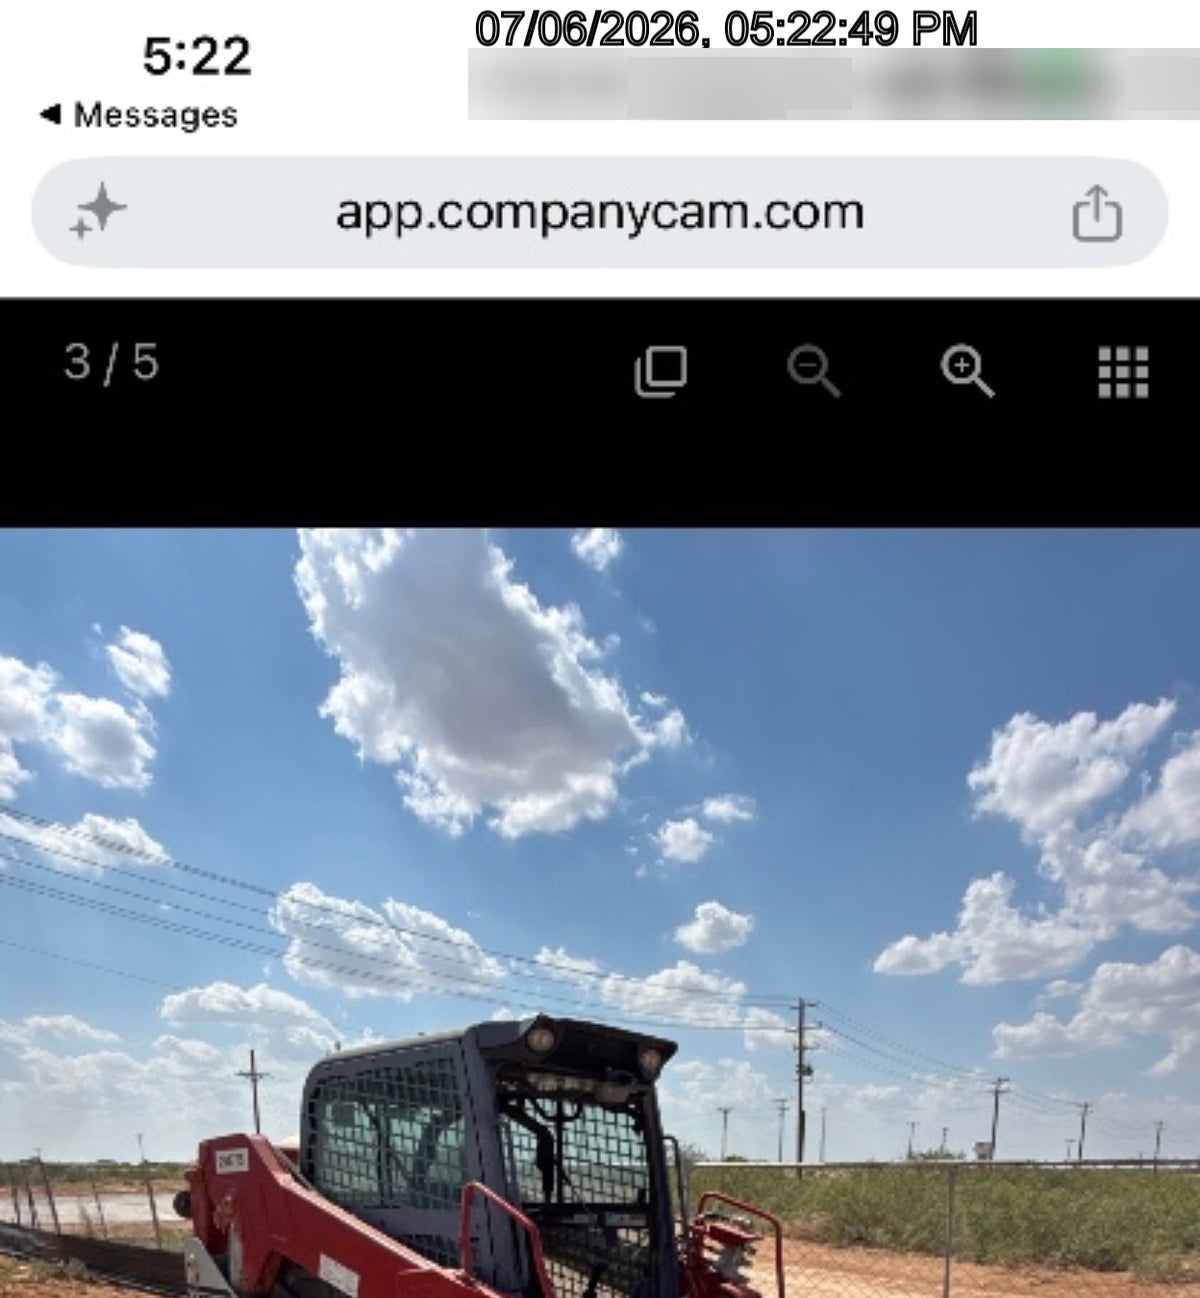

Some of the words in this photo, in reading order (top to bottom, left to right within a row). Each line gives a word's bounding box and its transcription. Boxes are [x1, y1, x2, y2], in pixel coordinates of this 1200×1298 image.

[143, 35, 252, 76] 5:22
[74, 101, 238, 134] Messages
[336, 200, 864, 240] app.companycam.com
